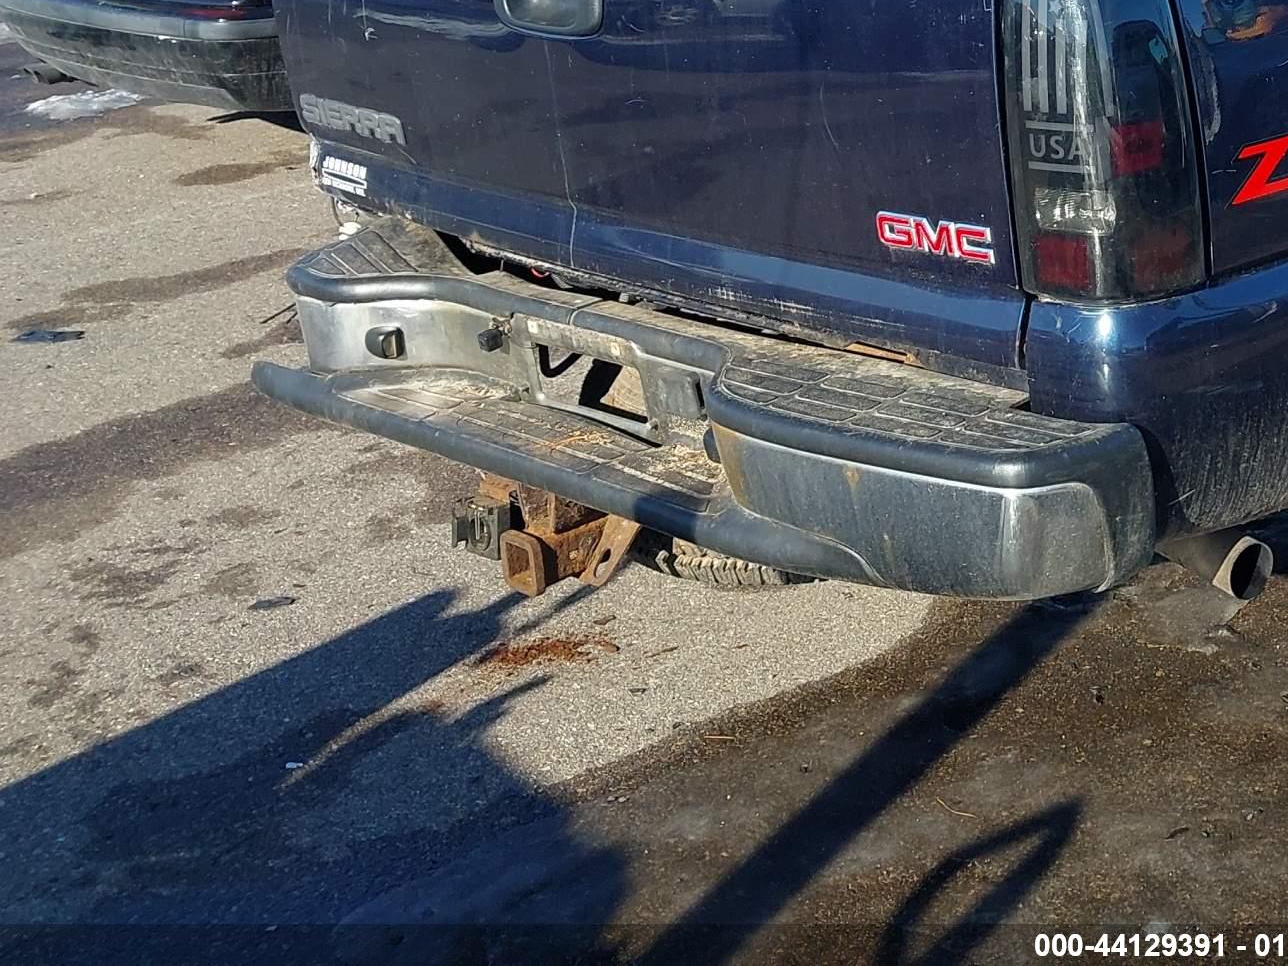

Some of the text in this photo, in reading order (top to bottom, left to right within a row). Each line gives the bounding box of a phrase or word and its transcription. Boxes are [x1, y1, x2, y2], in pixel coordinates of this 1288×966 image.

[300, 93, 406, 146] SIERRA
[1029, 133, 1087, 160] USA
[322, 155, 368, 180] JOHNSON
[876, 210, 996, 266] GMC
